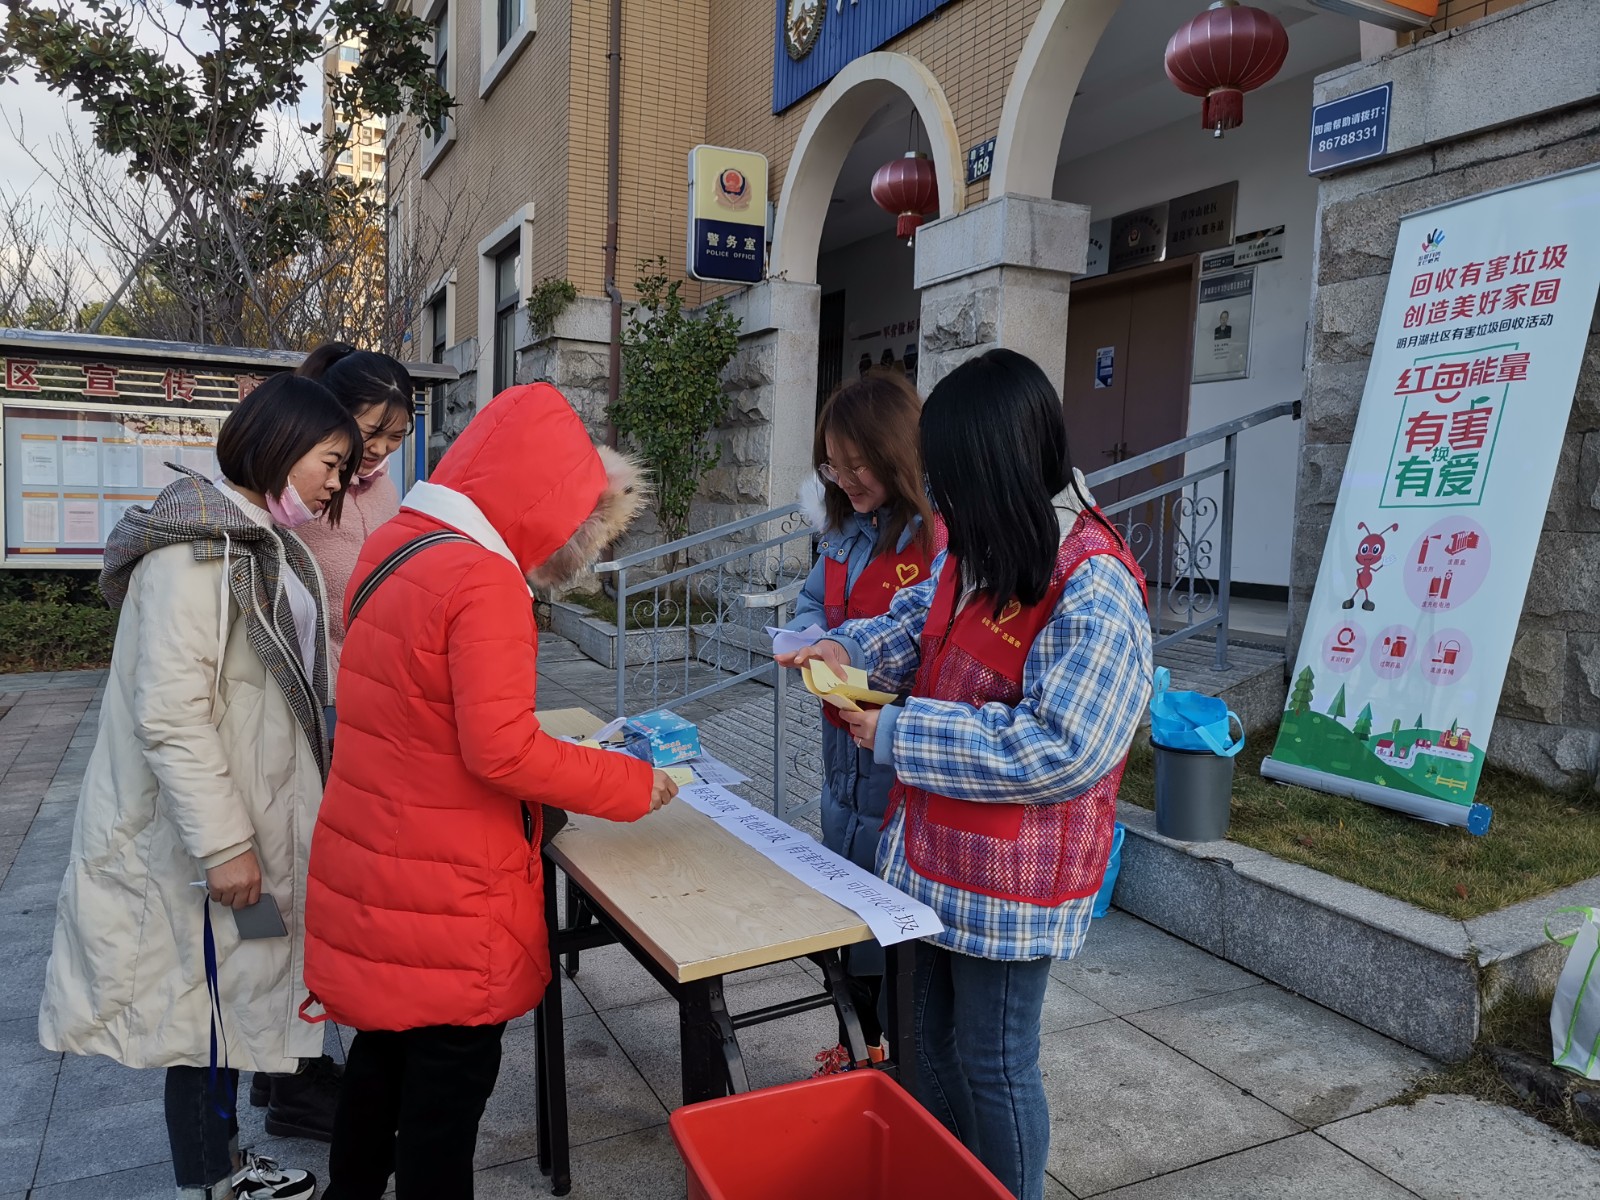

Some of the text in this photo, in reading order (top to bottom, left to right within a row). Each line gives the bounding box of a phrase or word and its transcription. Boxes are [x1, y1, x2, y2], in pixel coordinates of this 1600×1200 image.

[1318, 125, 1377, 152] 86788331
[973, 156, 989, 178] 158
[706, 249, 756, 260] POLICE OFFICE
[707, 232, 756, 251] 警务室
[1409, 244, 1568, 298] 回收有害垃圾
[1403, 278, 1561, 329] 创造美好家园
[1396, 314, 1554, 349] 明月湖社区有害垃圾回收活动
[1394, 352, 1531, 396] 红色能量
[1405, 407, 1493, 453] 有害
[1432, 447, 1450, 462] 换
[1395, 451, 1479, 498] 有爱
[734, 813, 791, 844] 其他垃圾
[785, 844, 850, 881] 有害垃圾
[847, 880, 920, 935] 可回收垃圾
